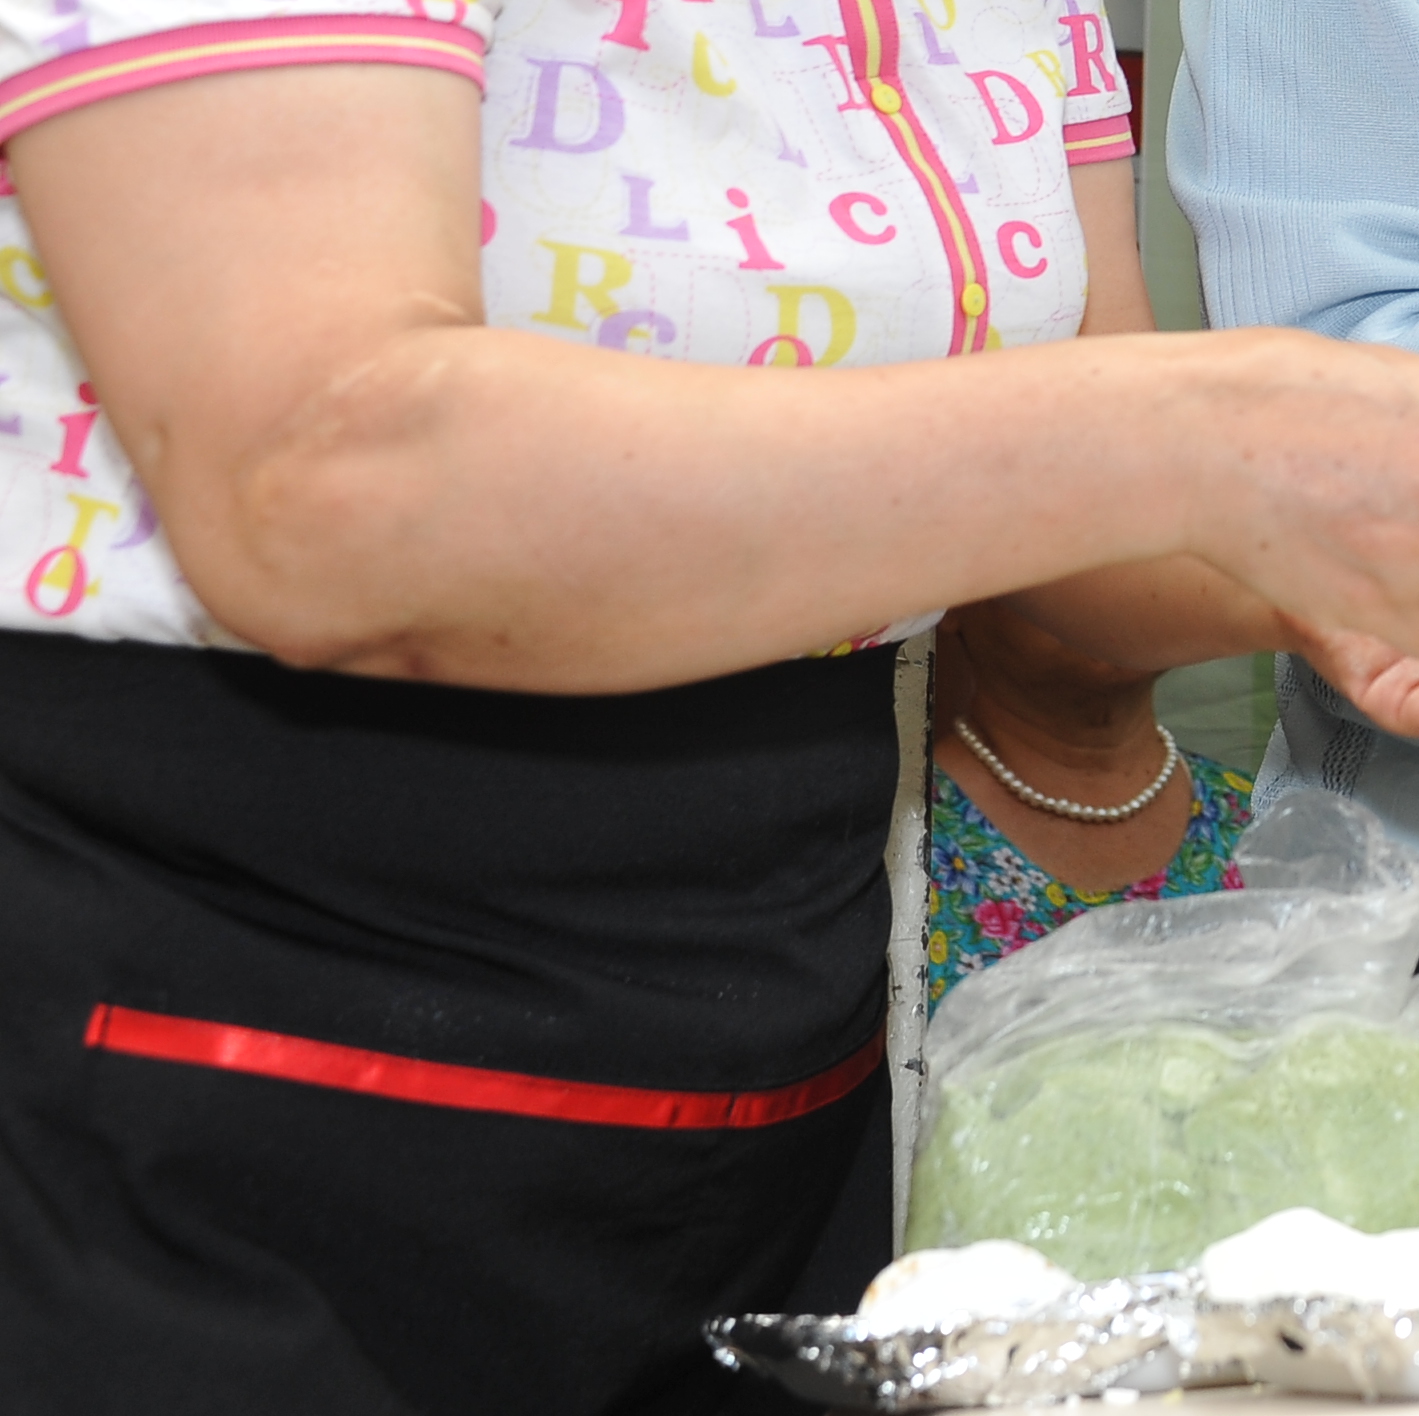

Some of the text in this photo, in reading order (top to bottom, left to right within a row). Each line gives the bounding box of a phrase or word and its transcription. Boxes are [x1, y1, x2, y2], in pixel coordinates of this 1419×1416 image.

[914, 12, 960, 65] L
[1058, 13, 1117, 97] R
[510, 60, 625, 152] D
[965, 70, 1044, 145] D
[621, 176, 690, 240] L
[726, 188, 785, 270] i
[532, 240, 632, 330] R
[50, 381, 99, 478] i
